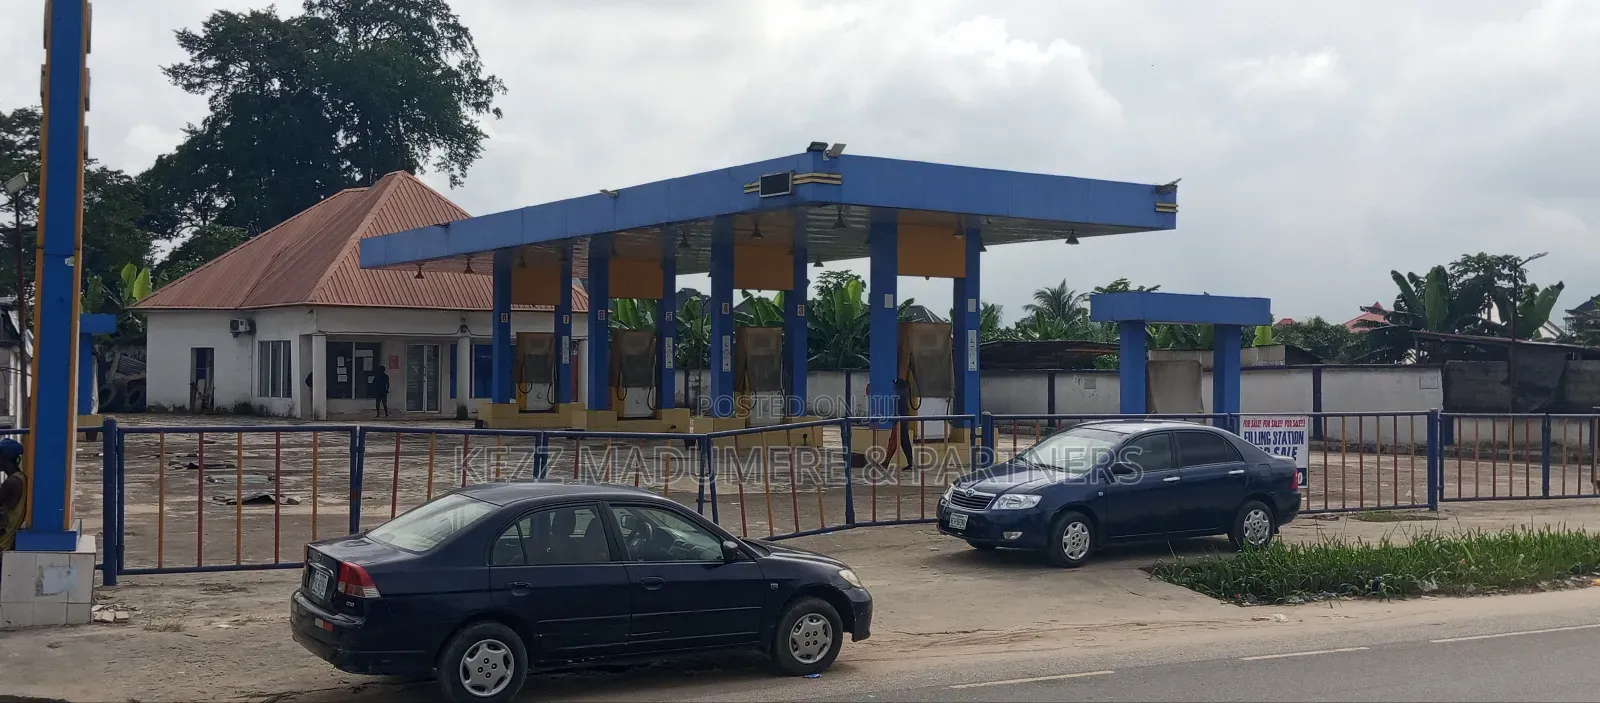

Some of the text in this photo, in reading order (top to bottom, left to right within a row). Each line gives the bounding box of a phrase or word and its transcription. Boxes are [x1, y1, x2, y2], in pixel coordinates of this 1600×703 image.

[1244, 431, 1304, 445] FILLING STATION
[1273, 447, 1298, 461] SALE
